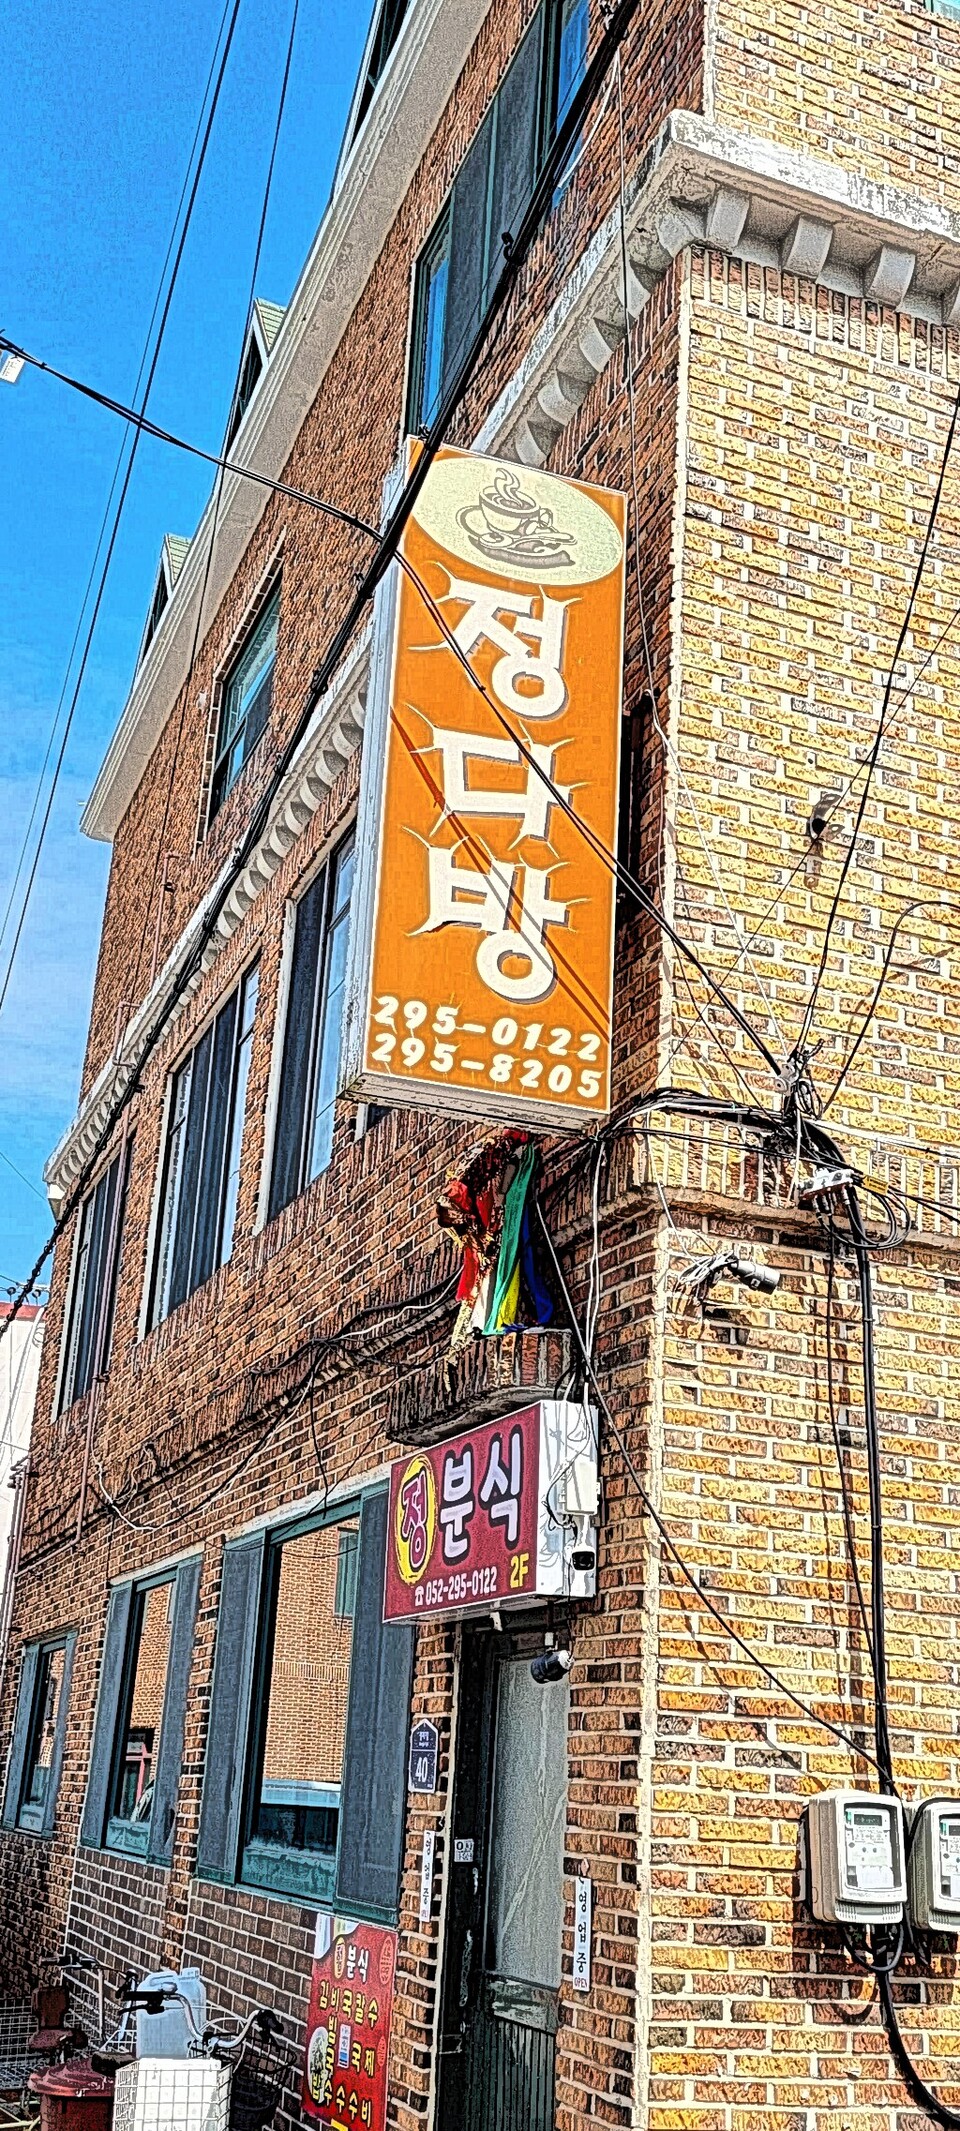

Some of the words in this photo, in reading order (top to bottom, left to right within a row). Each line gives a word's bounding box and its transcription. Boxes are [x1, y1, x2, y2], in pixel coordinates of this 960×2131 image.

[406, 566, 584, 1002] 정다방
[372, 995, 601, 1062] 295-0122
[371, 1032, 601, 1098] 295-8205
[402, 1470, 426, 1568] 정
[440, 1432, 521, 1558] 분식
[425, 1565, 498, 1606] 052-295-0122
[510, 1552, 529, 1589] 2F
[415, 1756, 428, 1783] 40
[346, 1944, 369, 1984] 분식
[576, 1890, 587, 1973] 영업중
